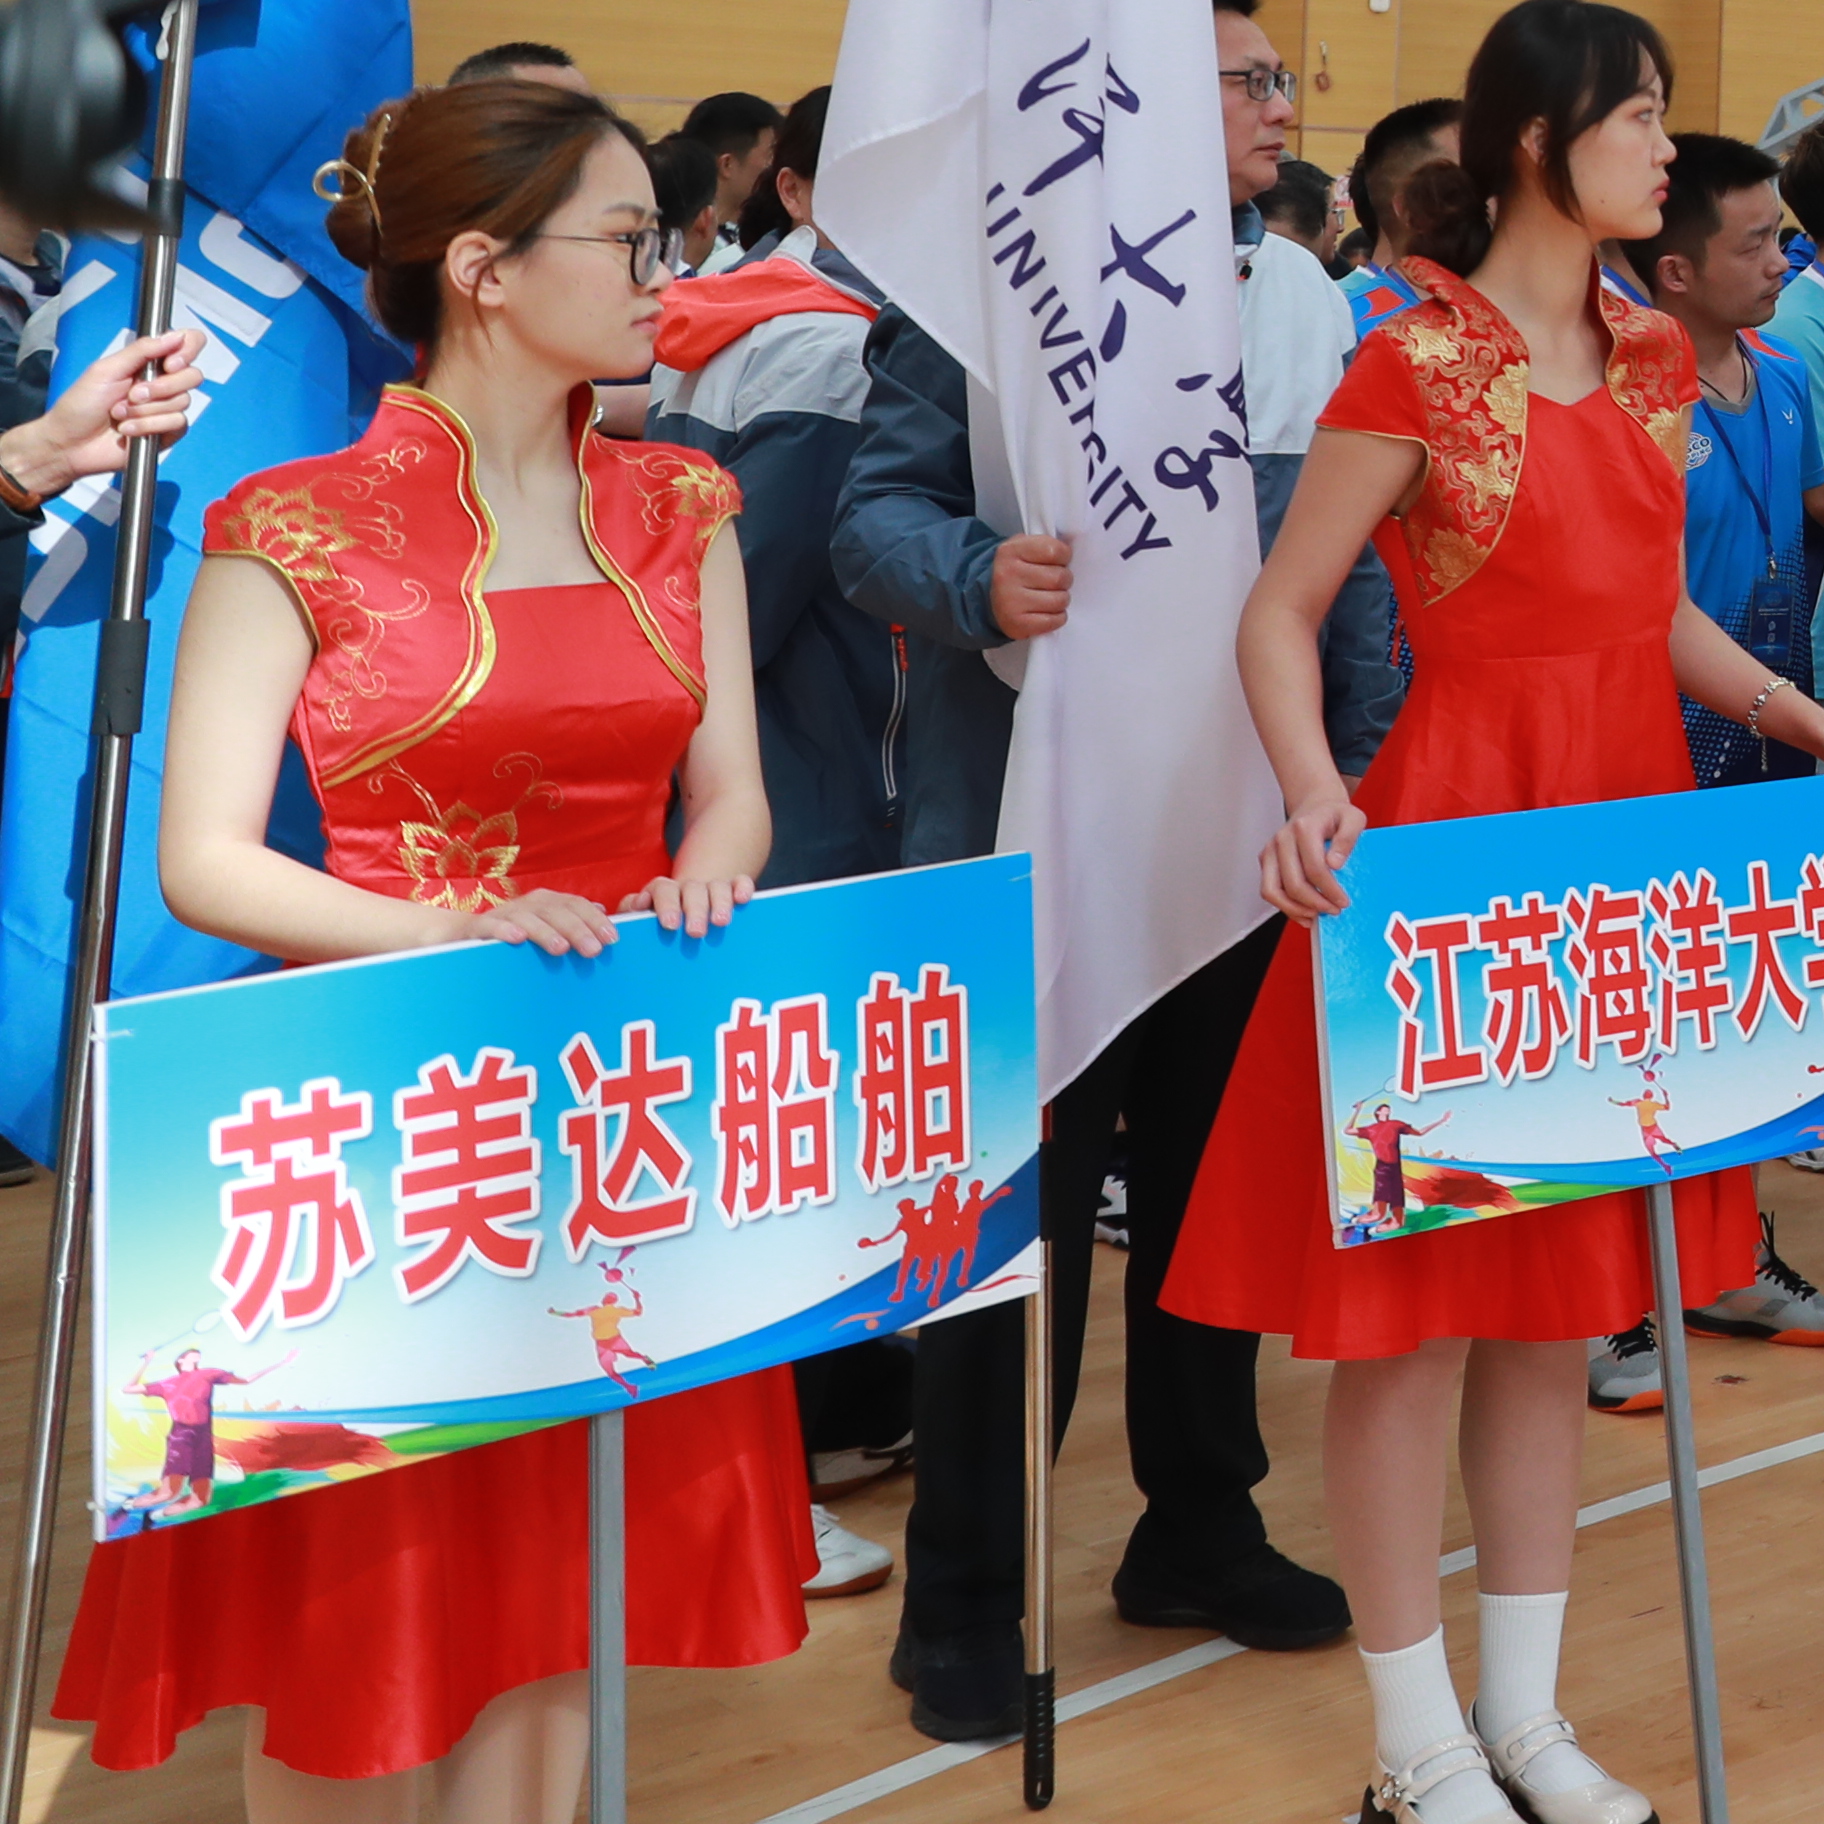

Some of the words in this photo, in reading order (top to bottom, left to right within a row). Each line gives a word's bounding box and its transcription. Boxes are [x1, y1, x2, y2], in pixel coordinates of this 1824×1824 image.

[209, 962, 971, 1343] 苏美达船舶
